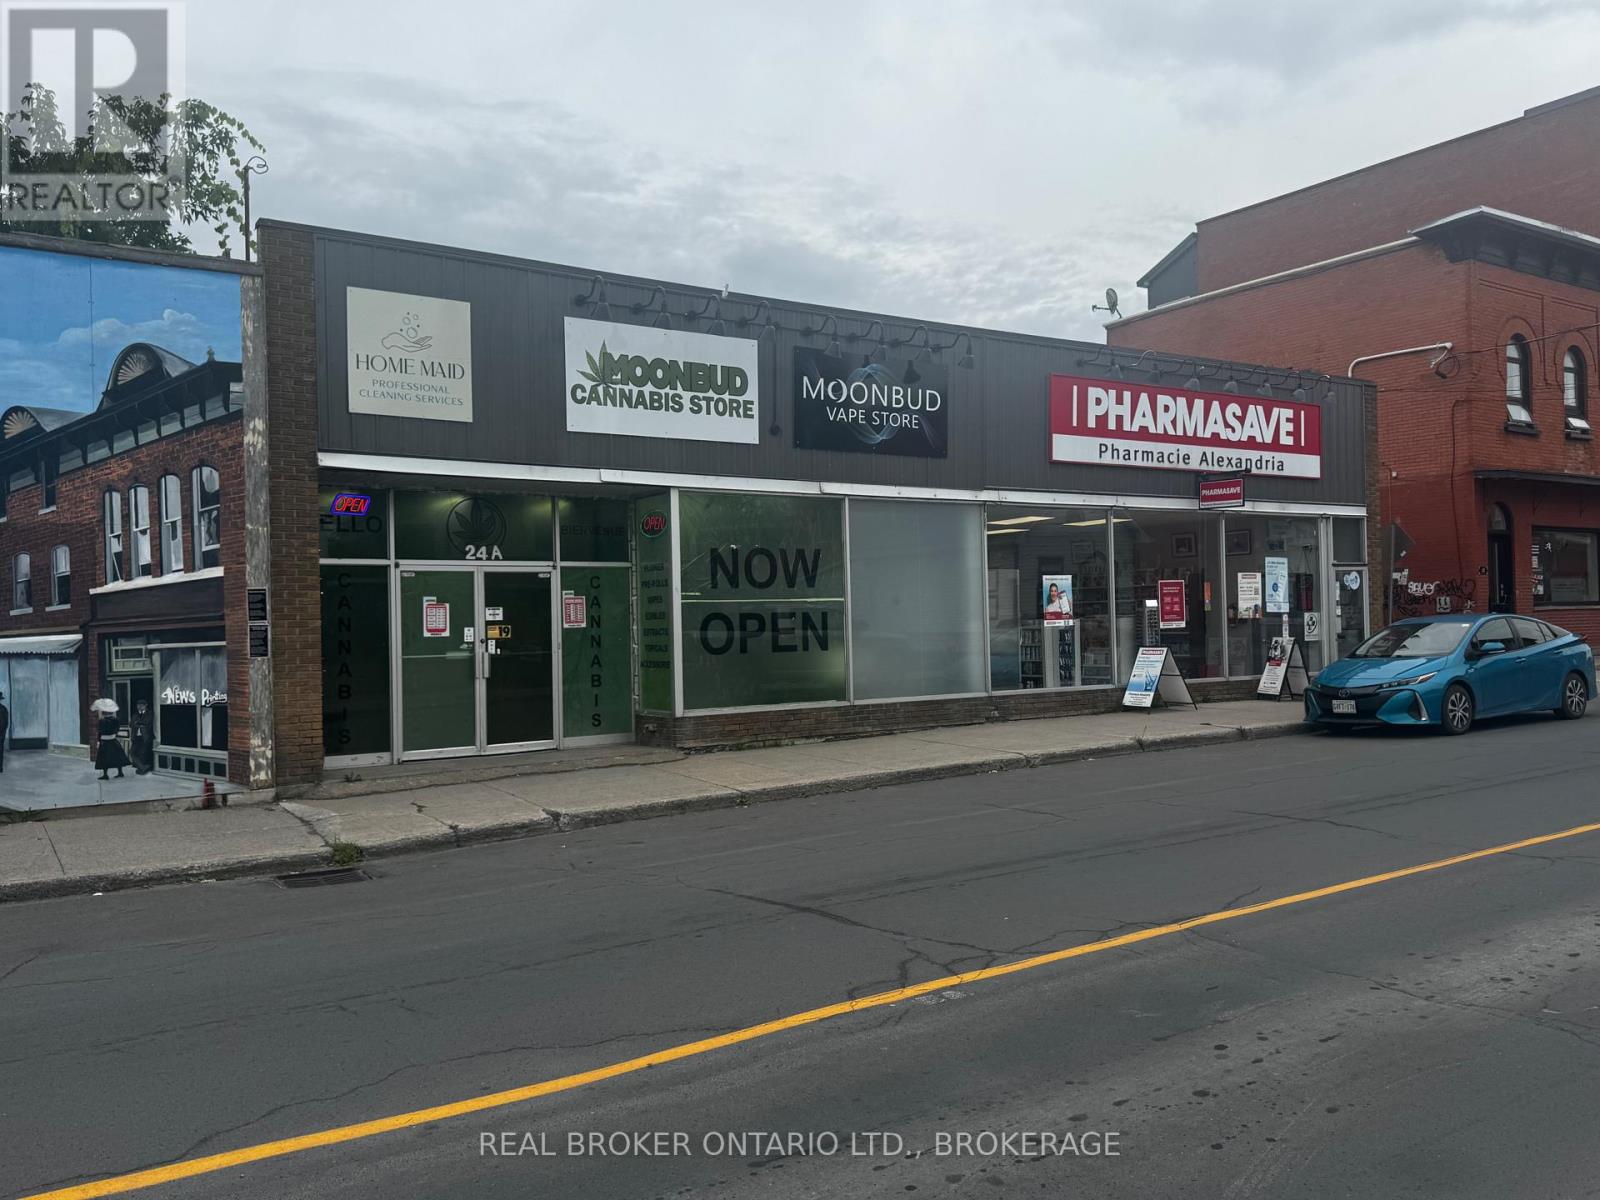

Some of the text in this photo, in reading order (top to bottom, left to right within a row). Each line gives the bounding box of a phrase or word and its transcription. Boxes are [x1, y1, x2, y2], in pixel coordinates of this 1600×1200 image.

[356, 353, 465, 380] HOME MAID
[602, 351, 748, 397] MOONBUD
[359, 388, 464, 406] CLEANING SERVICES
[372, 379, 449, 394] PROFESSIONAL
[570, 384, 755, 419] CANNABIS STORE
[802, 376, 941, 412] MOONBUD
[826, 406, 920, 429] VAPE STORE
[1087, 386, 1294, 446] PHARMASAVE
[1099, 443, 1285, 473] Pharmacie Alexandria
[334, 496, 369, 512] OPEN
[1201, 486, 1241, 496] PHARMASAVE
[320, 514, 382, 533] ELLO
[643, 516, 666, 530] OPEN
[710, 547, 821, 590] NOW
[699, 611, 829, 656] OPEN
[338, 572, 352, 744] CANNABIS
[590, 575, 602, 728] CANNABIS
